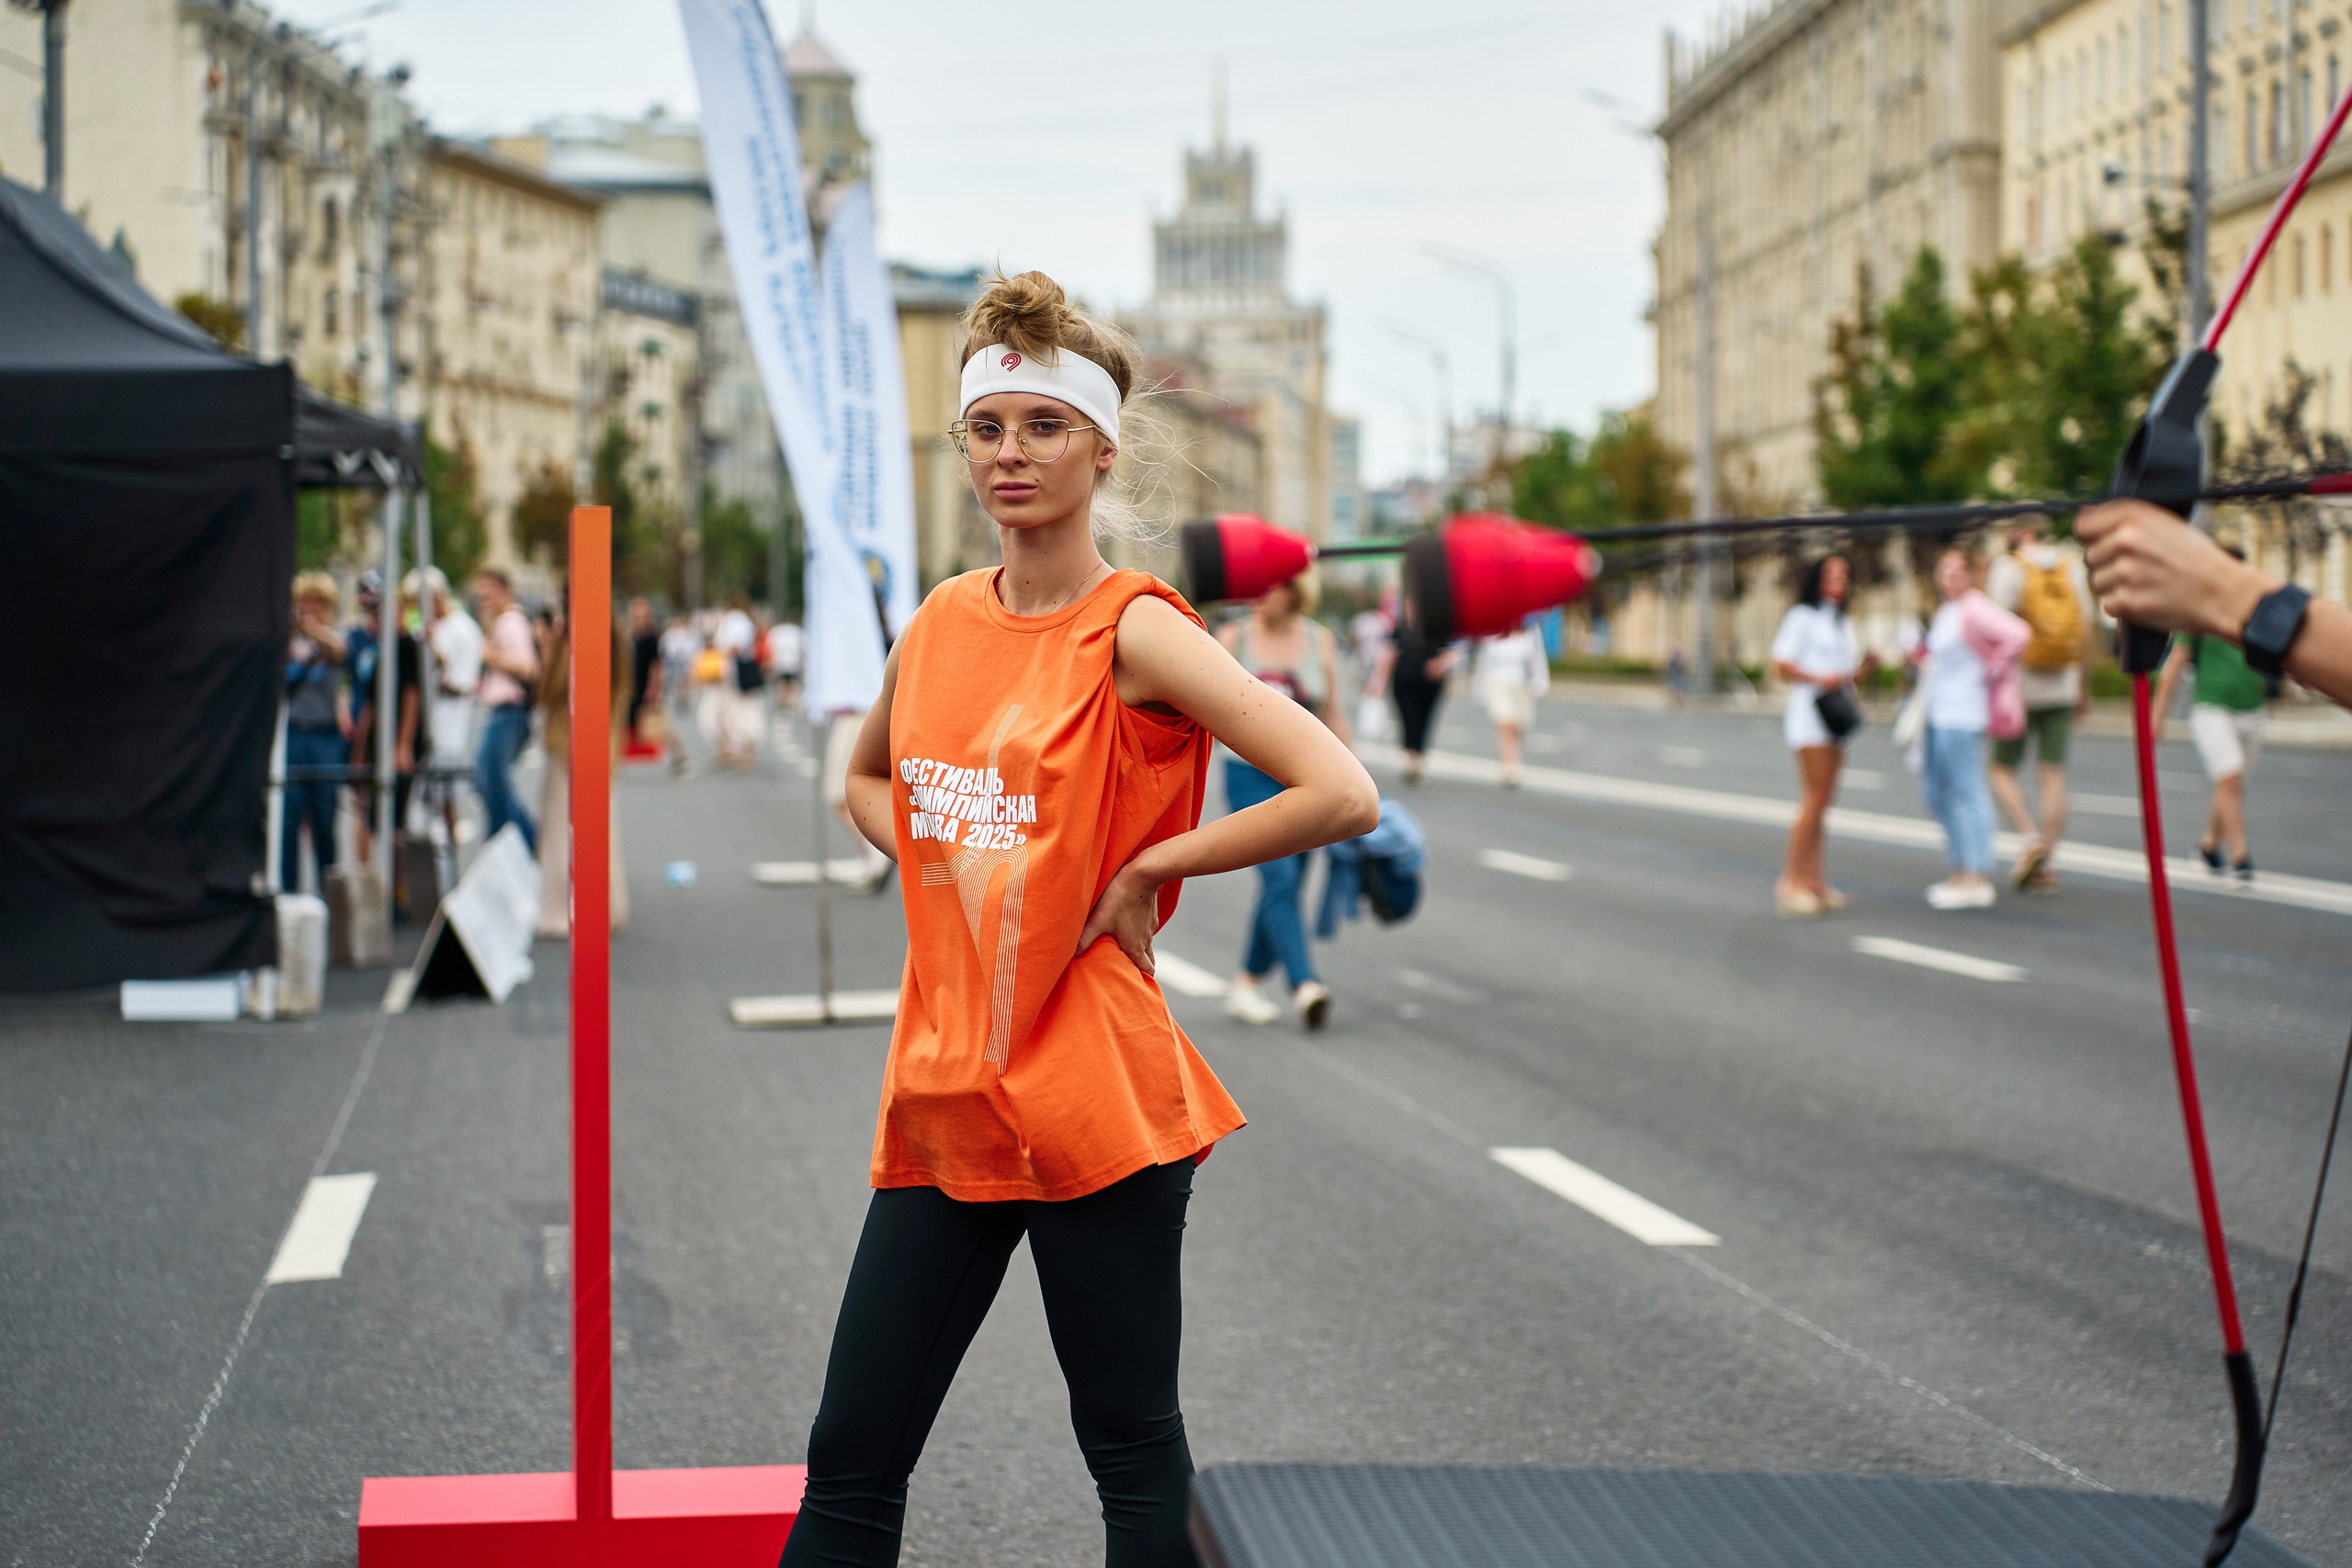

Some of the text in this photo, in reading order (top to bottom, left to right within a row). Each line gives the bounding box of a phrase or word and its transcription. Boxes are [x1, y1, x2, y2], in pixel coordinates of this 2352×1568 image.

[900, 758, 1004, 796] ФЕСТИВАЛЬ
[910, 811, 1027, 850] МОВА 2025»
